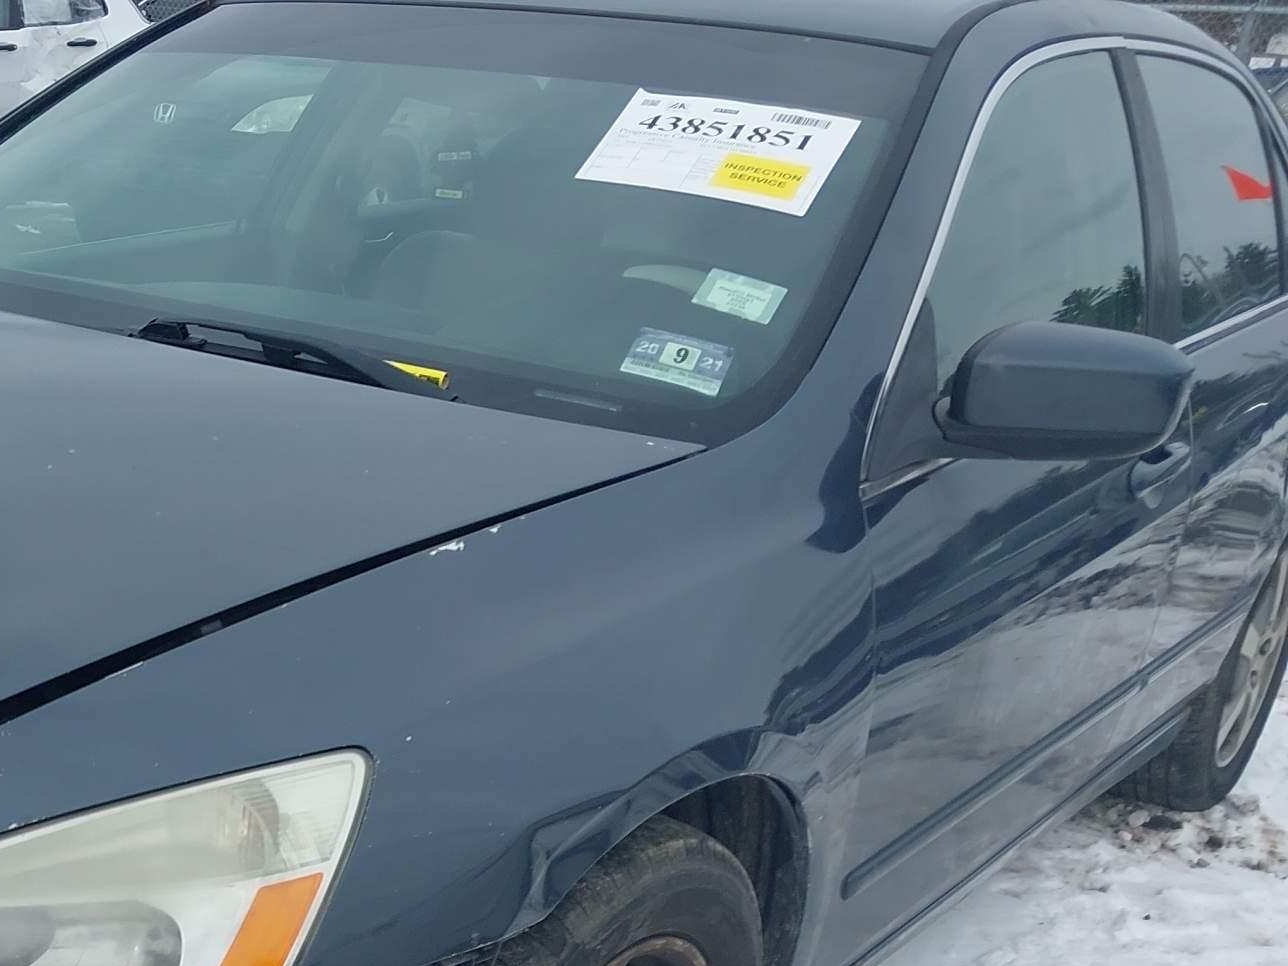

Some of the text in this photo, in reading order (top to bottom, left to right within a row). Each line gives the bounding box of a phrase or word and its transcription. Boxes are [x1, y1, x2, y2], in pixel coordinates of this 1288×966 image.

[639, 113, 814, 151] 43851851
[724, 162, 803, 182] INSPECTION
[729, 172, 787, 189] SERVICE
[636, 340, 660, 355] 20
[672, 347, 690, 365] 9
[701, 356, 724, 372] 21
